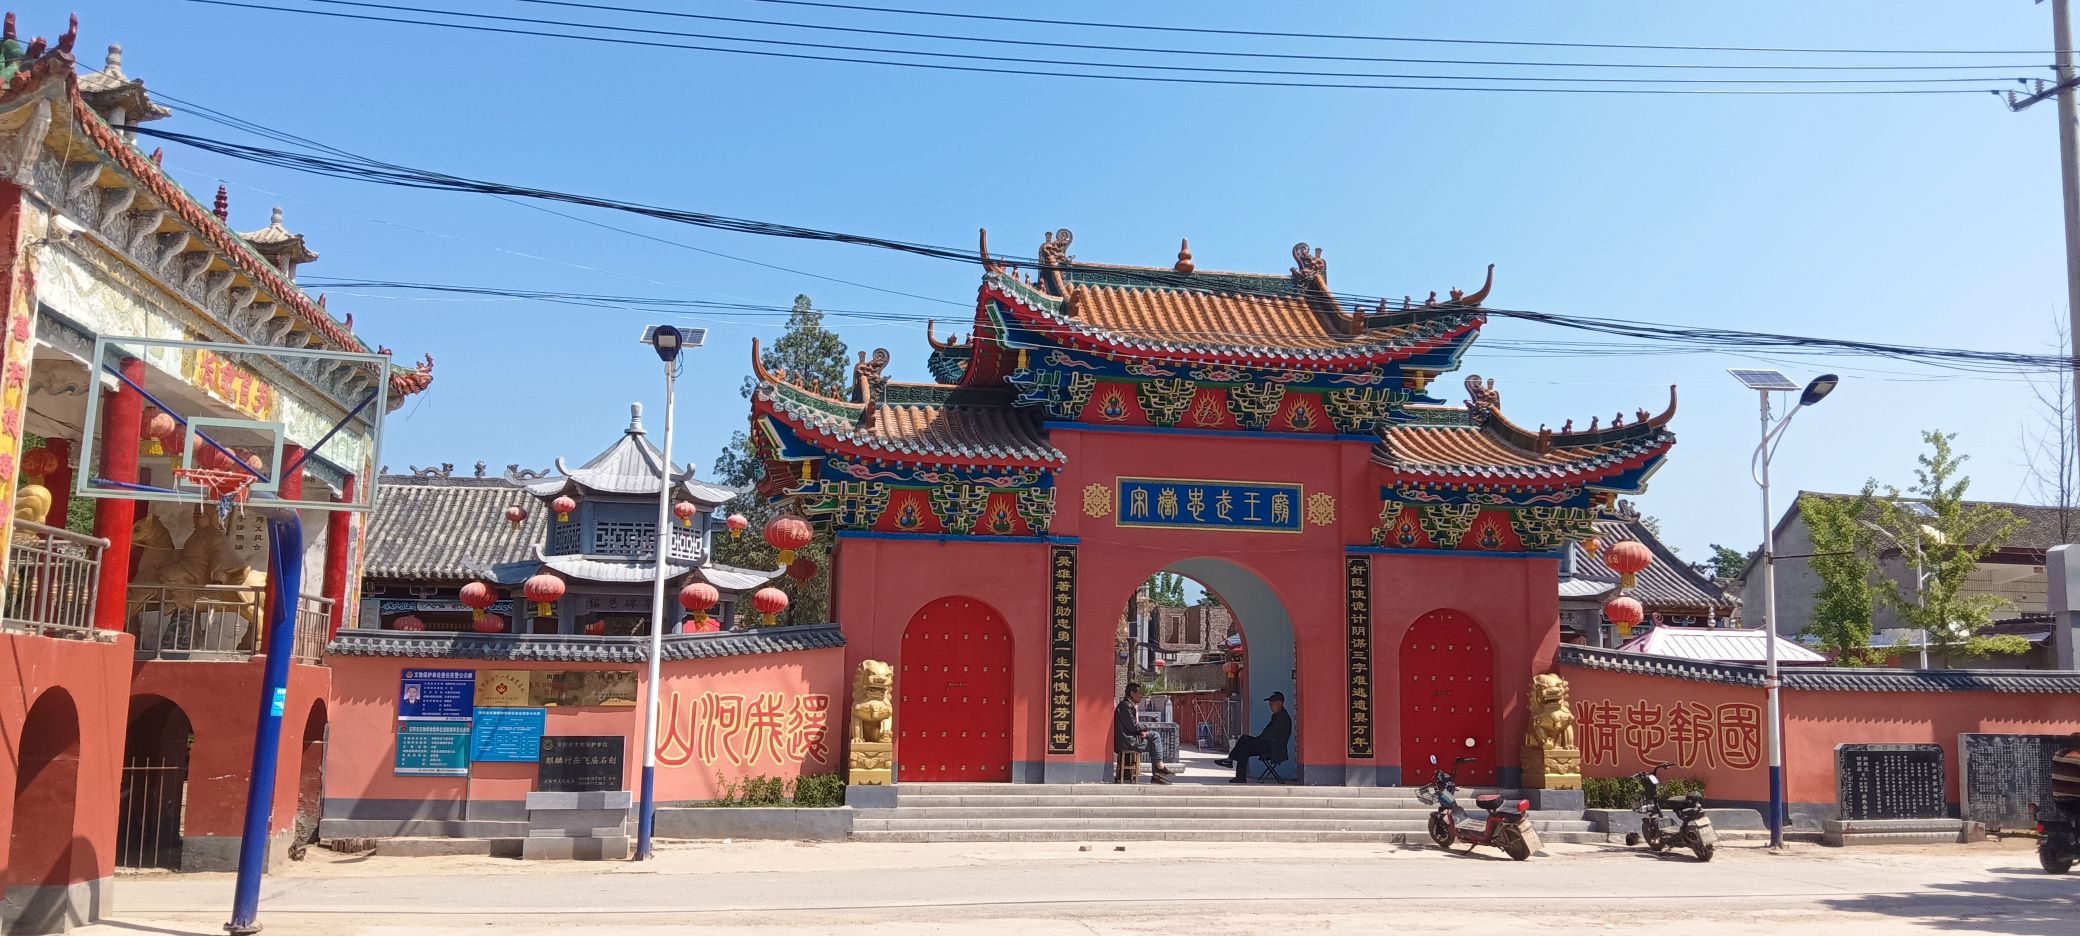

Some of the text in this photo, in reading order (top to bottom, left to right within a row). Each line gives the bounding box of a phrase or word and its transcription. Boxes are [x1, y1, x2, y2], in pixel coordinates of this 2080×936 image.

[1052, 555, 1073, 744] 英雄著奇勋忠勇一生不愧流芳百世
